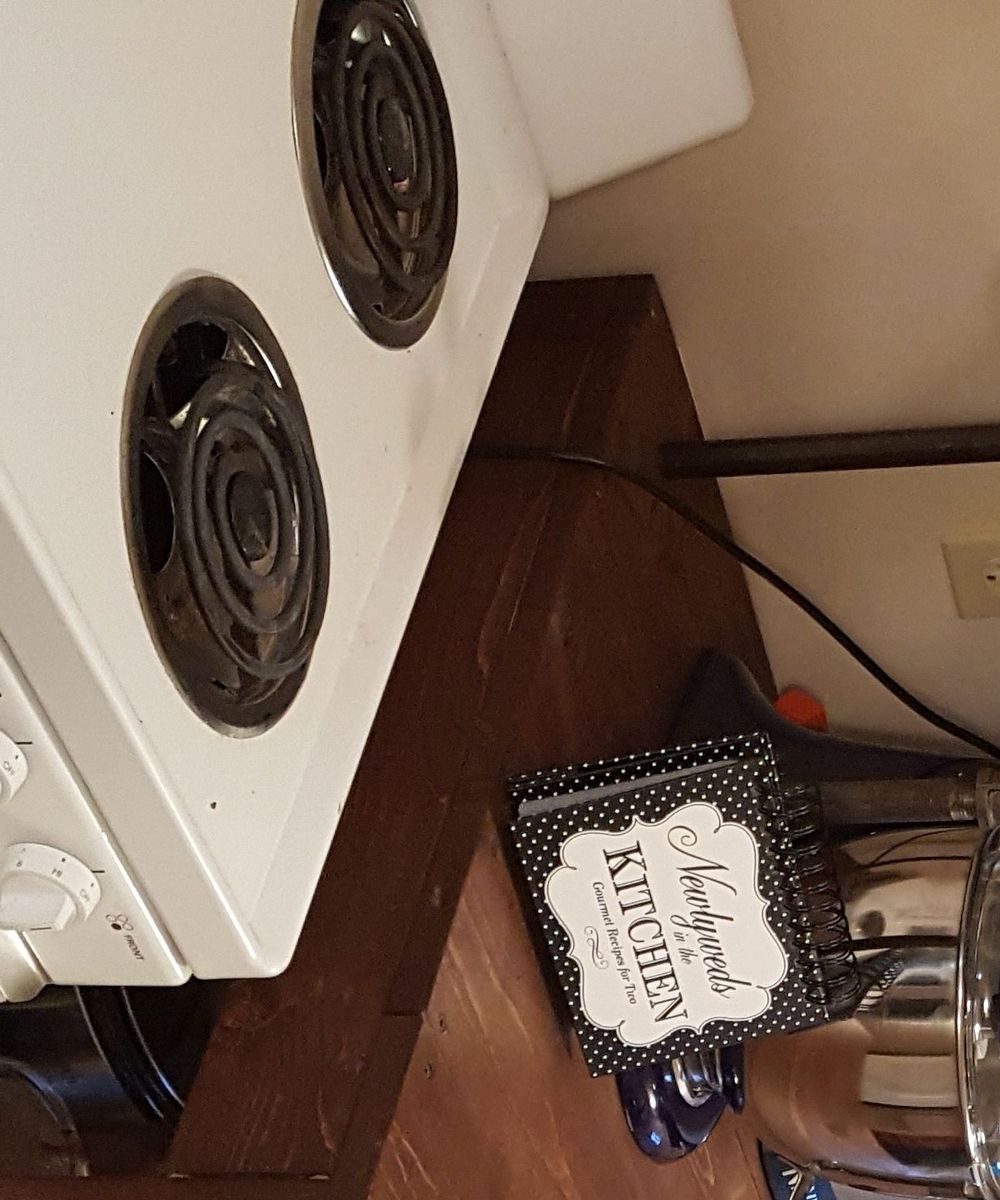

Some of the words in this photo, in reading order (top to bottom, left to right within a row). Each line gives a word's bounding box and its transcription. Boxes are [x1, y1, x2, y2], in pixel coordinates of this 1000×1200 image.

[123, 934, 146, 961] FRONT
[592, 881, 614, 926] Gourmet
[606, 928, 626, 966] Recipes
[617, 967, 631, 983] for
[625, 983, 637, 1005] Two
[602, 840, 689, 1023] KITCHEN
[667, 825, 752, 999] Newlyweds
[672, 931, 687, 943] in
[678, 946, 699, 967] the
